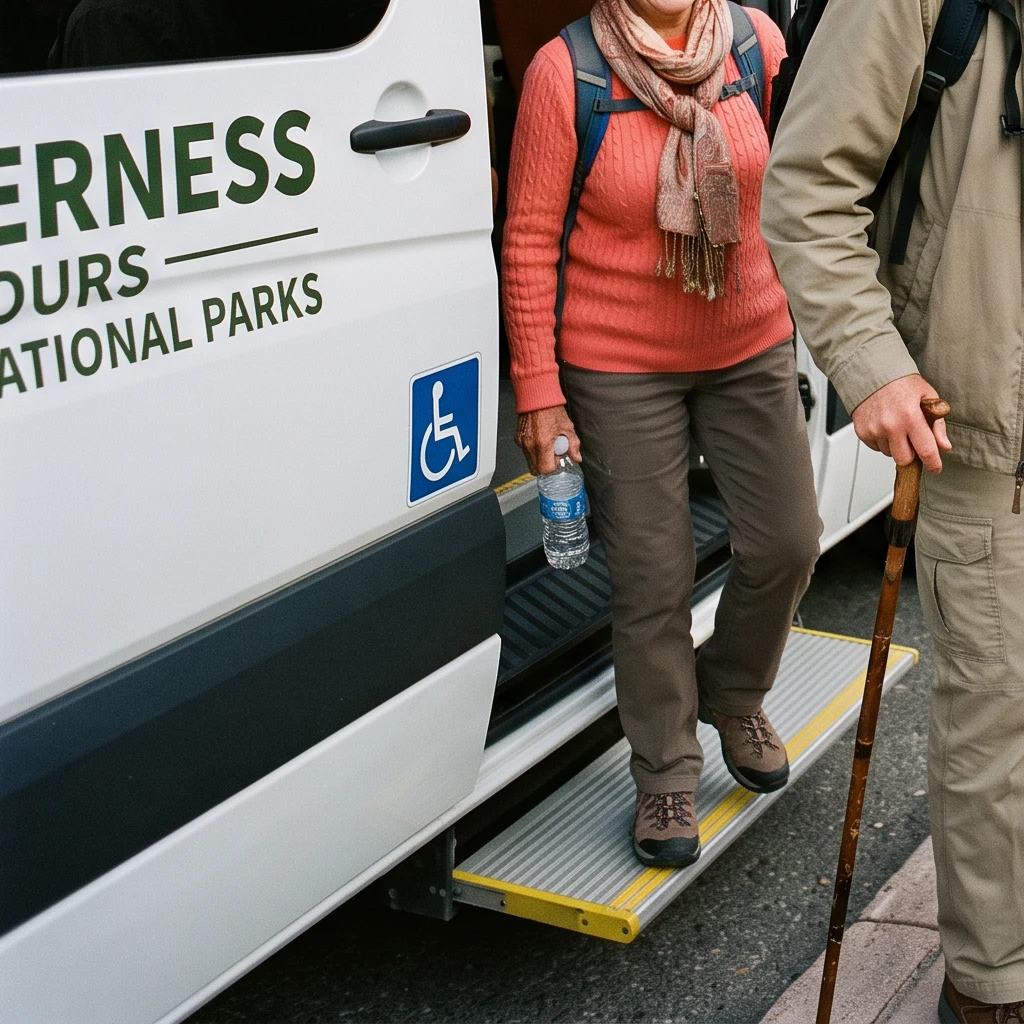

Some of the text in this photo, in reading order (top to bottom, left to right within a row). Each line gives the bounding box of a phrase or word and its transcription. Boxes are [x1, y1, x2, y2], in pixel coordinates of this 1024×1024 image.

[0, 245, 150, 325] OURS
[0, 272, 324, 399] ATIONAL PARKS
